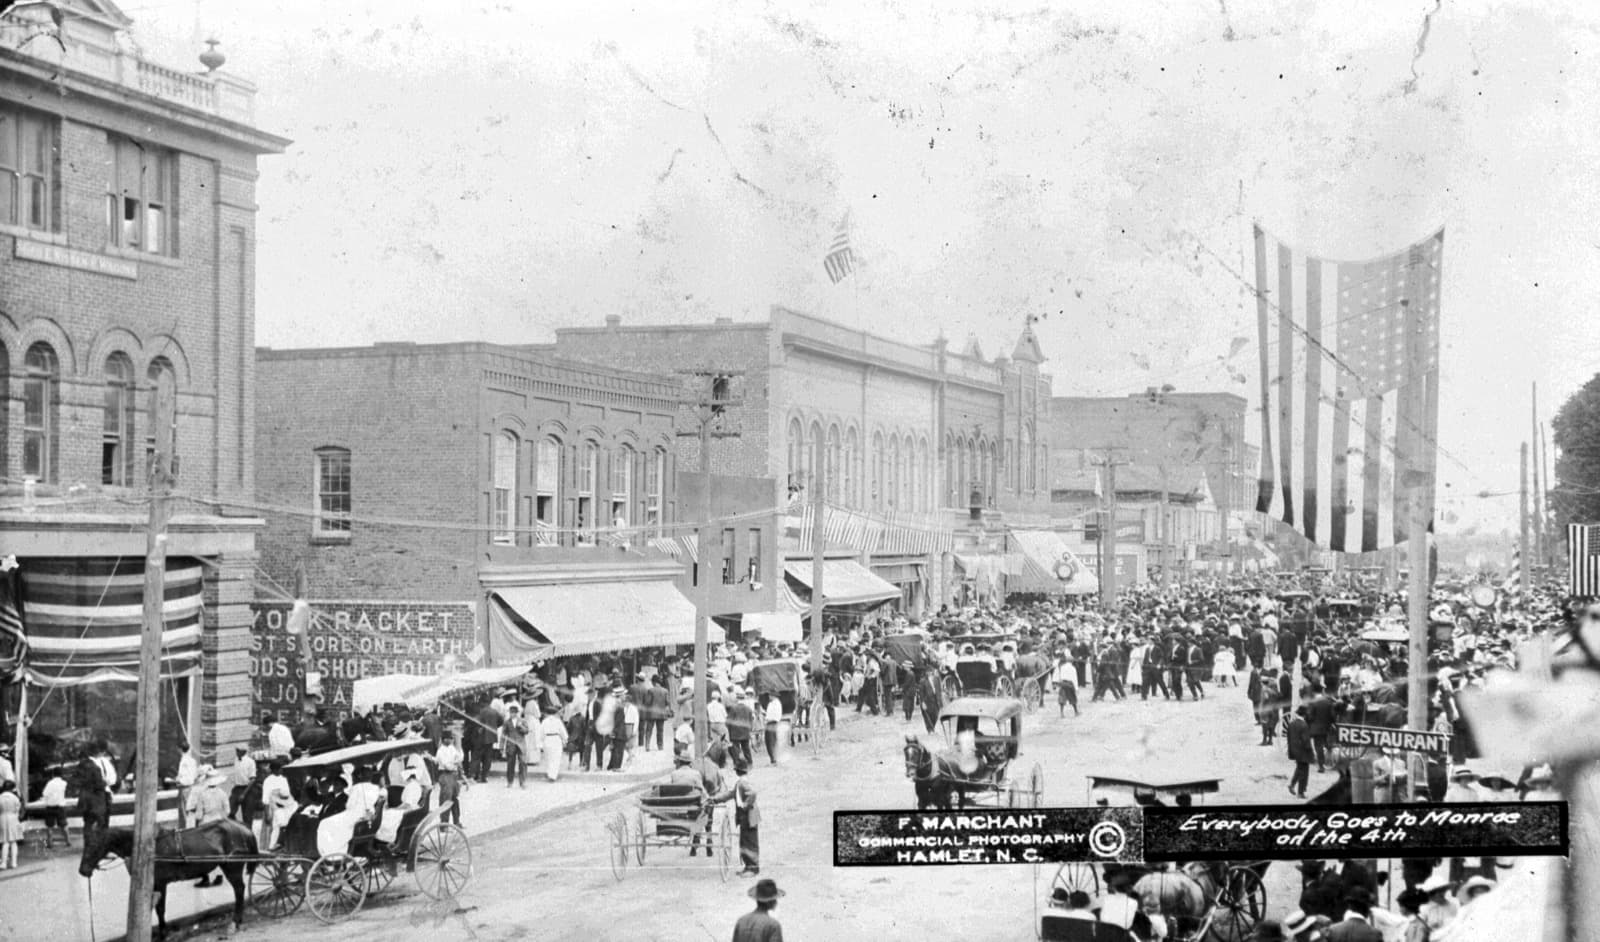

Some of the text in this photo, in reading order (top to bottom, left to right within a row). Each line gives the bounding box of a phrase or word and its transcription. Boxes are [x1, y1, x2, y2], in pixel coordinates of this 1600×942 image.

[335, 610, 453, 632] RACKET
[286, 636, 352, 653] SORE
[360, 638, 386, 654] ON
[317, 659, 373, 679] SHOE
[1339, 727, 1450, 752] RESTAURANT
